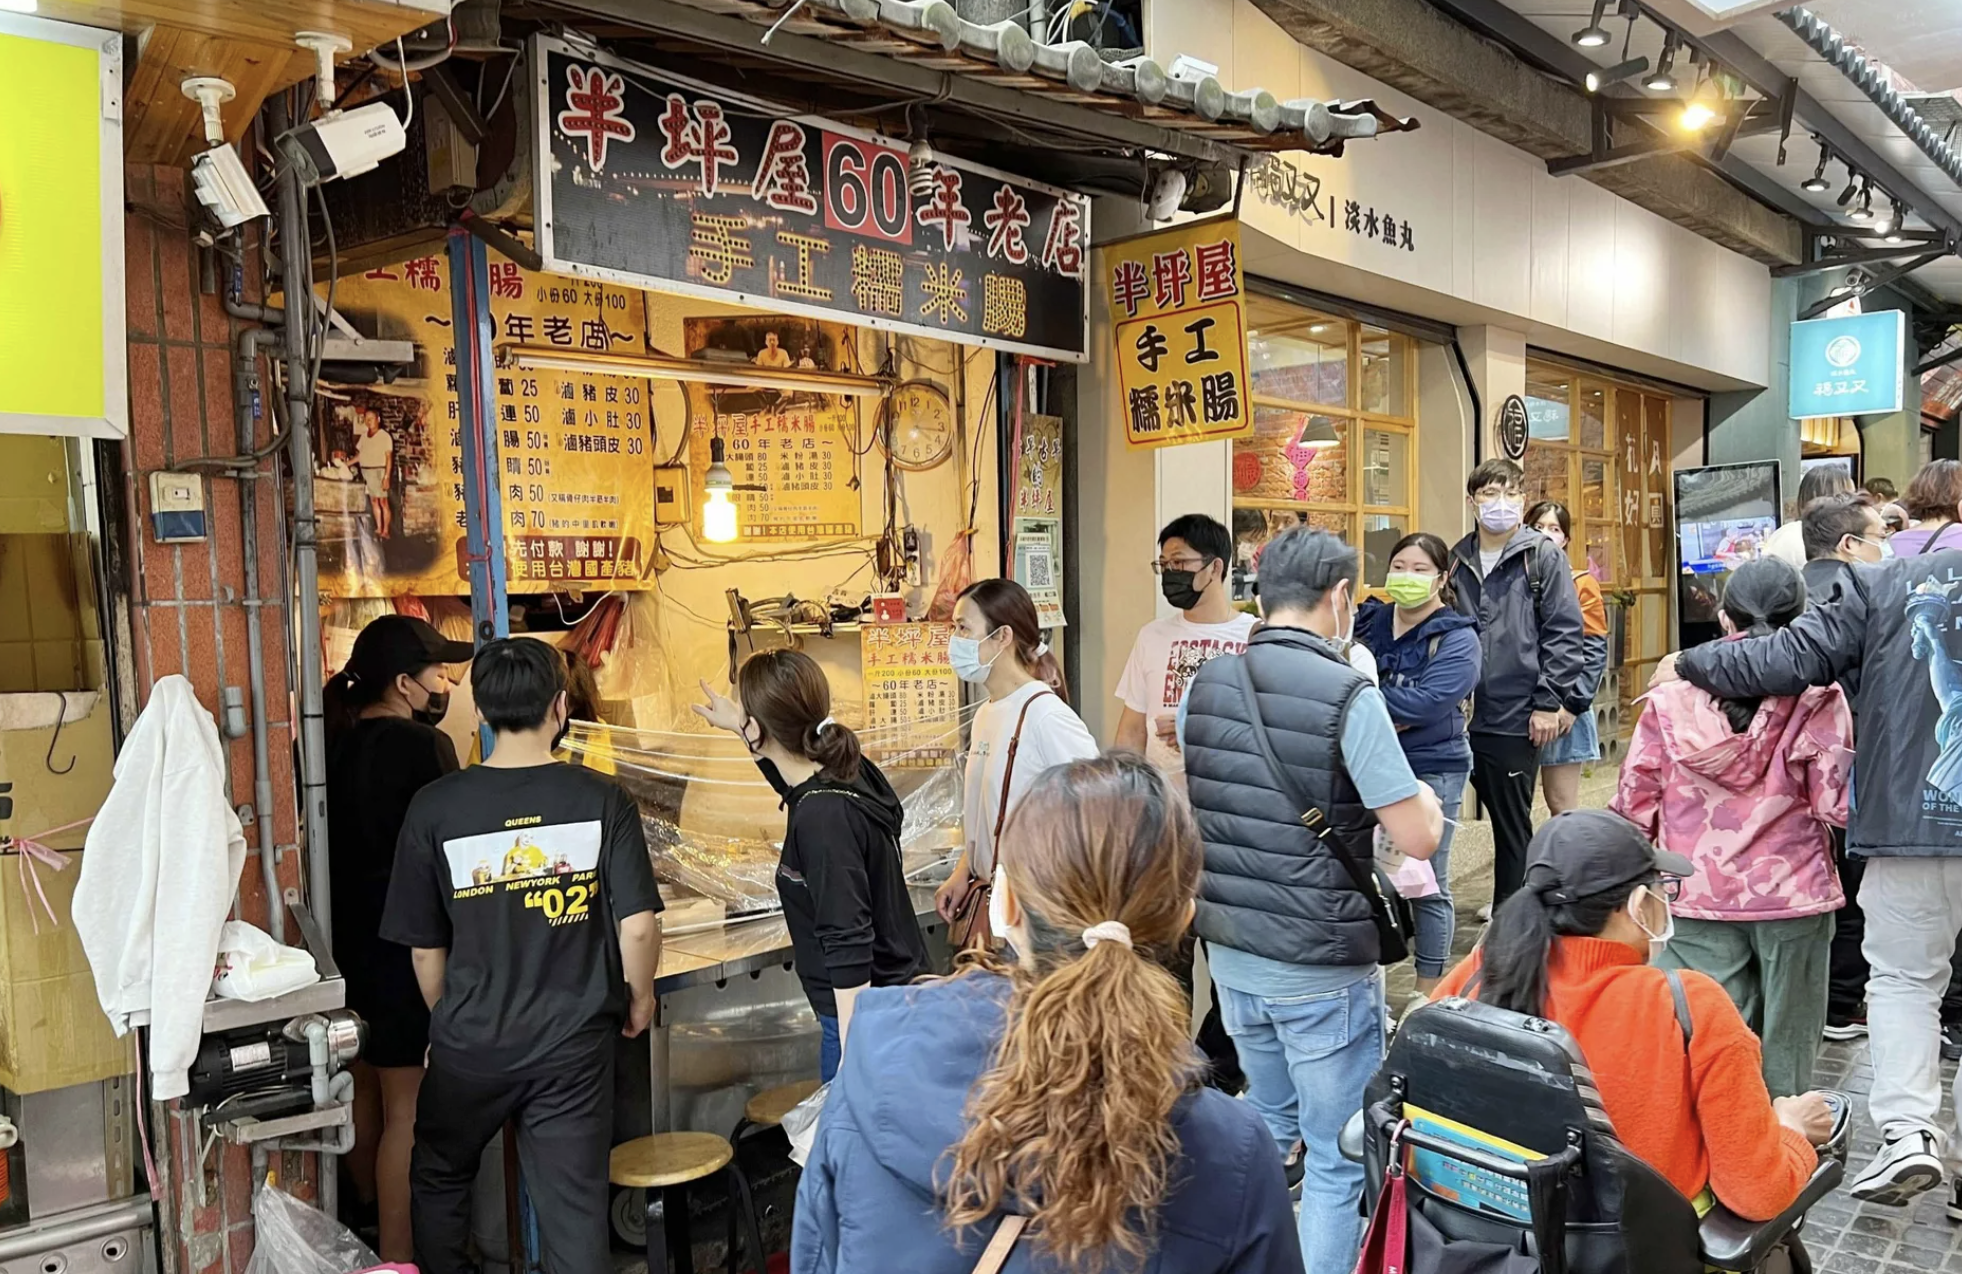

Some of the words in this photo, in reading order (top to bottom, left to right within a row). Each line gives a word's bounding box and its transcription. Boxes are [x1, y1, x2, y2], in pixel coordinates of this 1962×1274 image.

[1345, 199, 1415, 252] 淡水魚丸
[688, 213, 1026, 338] 手工糯米腸
[1113, 238, 1240, 317] 半坪屋
[1135, 317, 1220, 372] 手工
[521, 379, 538, 397] 25
[624, 387, 640, 405] 30
[910, 397, 920, 407] 12
[1128, 371, 1240, 434] 糯米腸
[927, 401, 930, 410] 1
[524, 405, 540, 423] 50
[626, 412, 641, 430] 30
[934, 409, 940, 419] 2
[938, 422, 945, 432] 3
[527, 431, 541, 449] 50
[627, 437, 643, 455] 30
[822, 452, 832, 460] 30
[901, 445, 907, 454] 7
[914, 447, 920, 458] 6
[757, 453, 767, 461] 80
[528, 458, 542, 475] 50
[758, 462, 768, 471] 25
[822, 462, 832, 471] 30
[758, 473, 768, 482] 50
[822, 472, 832, 481] 30
[529, 484, 543, 502] 50
[823, 482, 833, 491] 30
[759, 493, 769, 502] 50
[531, 511, 545, 528] 70
[867, 626, 949, 650] 半坪屋
[1922, 802, 1937, 811] OF
[1939, 803, 1960, 813] THE
[505, 815, 542, 827] QUEENS
[453, 885, 494, 899] LONDON
[505, 876, 561, 891] NEWYORK
